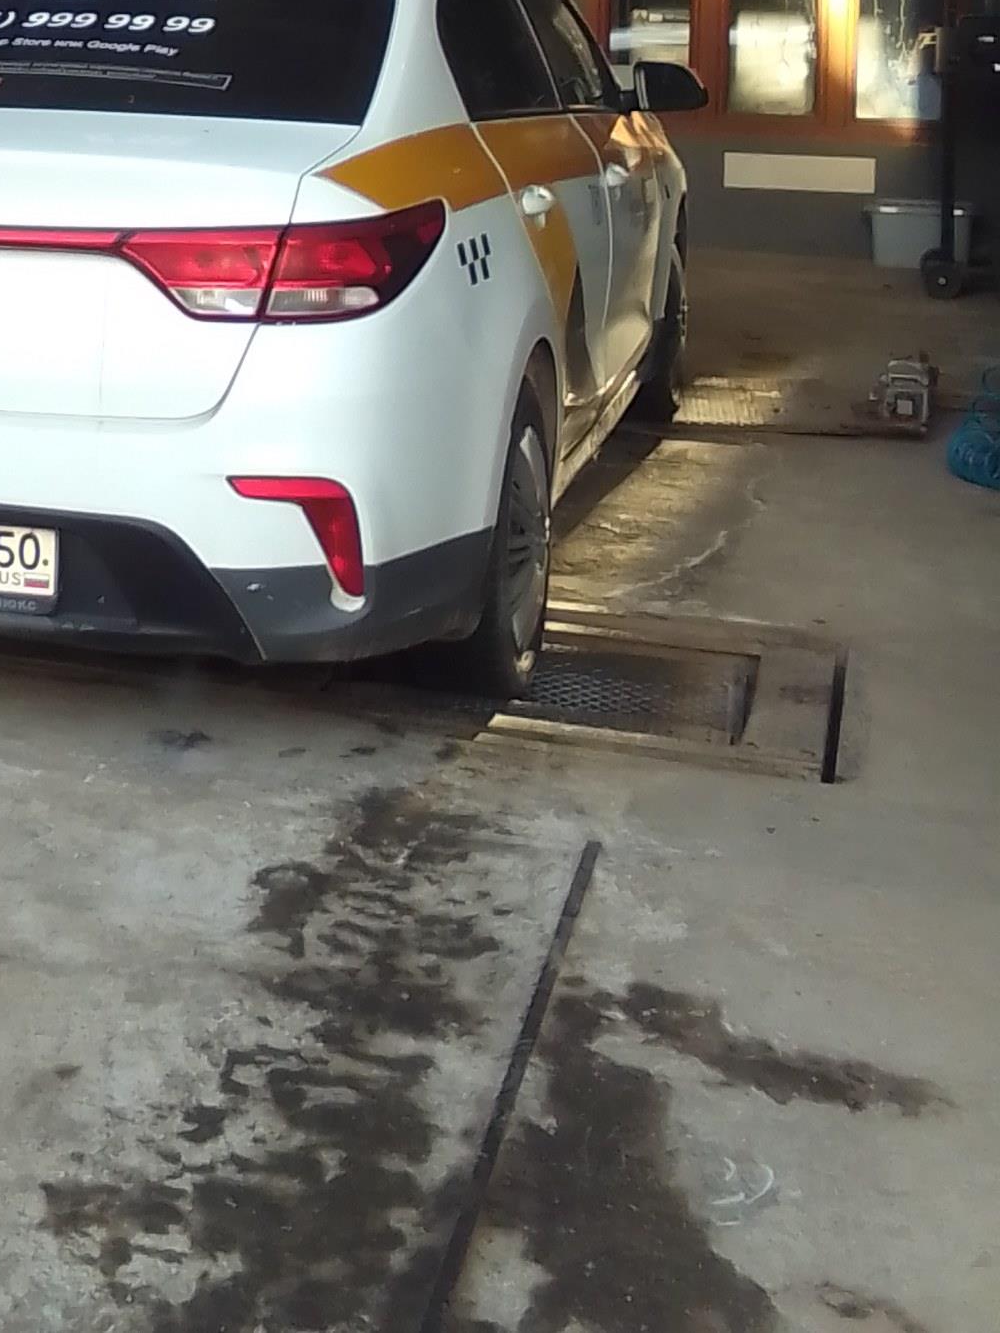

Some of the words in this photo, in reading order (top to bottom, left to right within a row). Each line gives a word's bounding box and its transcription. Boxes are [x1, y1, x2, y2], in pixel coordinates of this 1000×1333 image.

[21, 11, 98, 29] 999
[103, 13, 156, 31] 99
[162, 16, 216, 34] 99
[12, 36, 52, 47] Store
[87, 39, 141, 53] Google
[144, 43, 180, 57] Play
